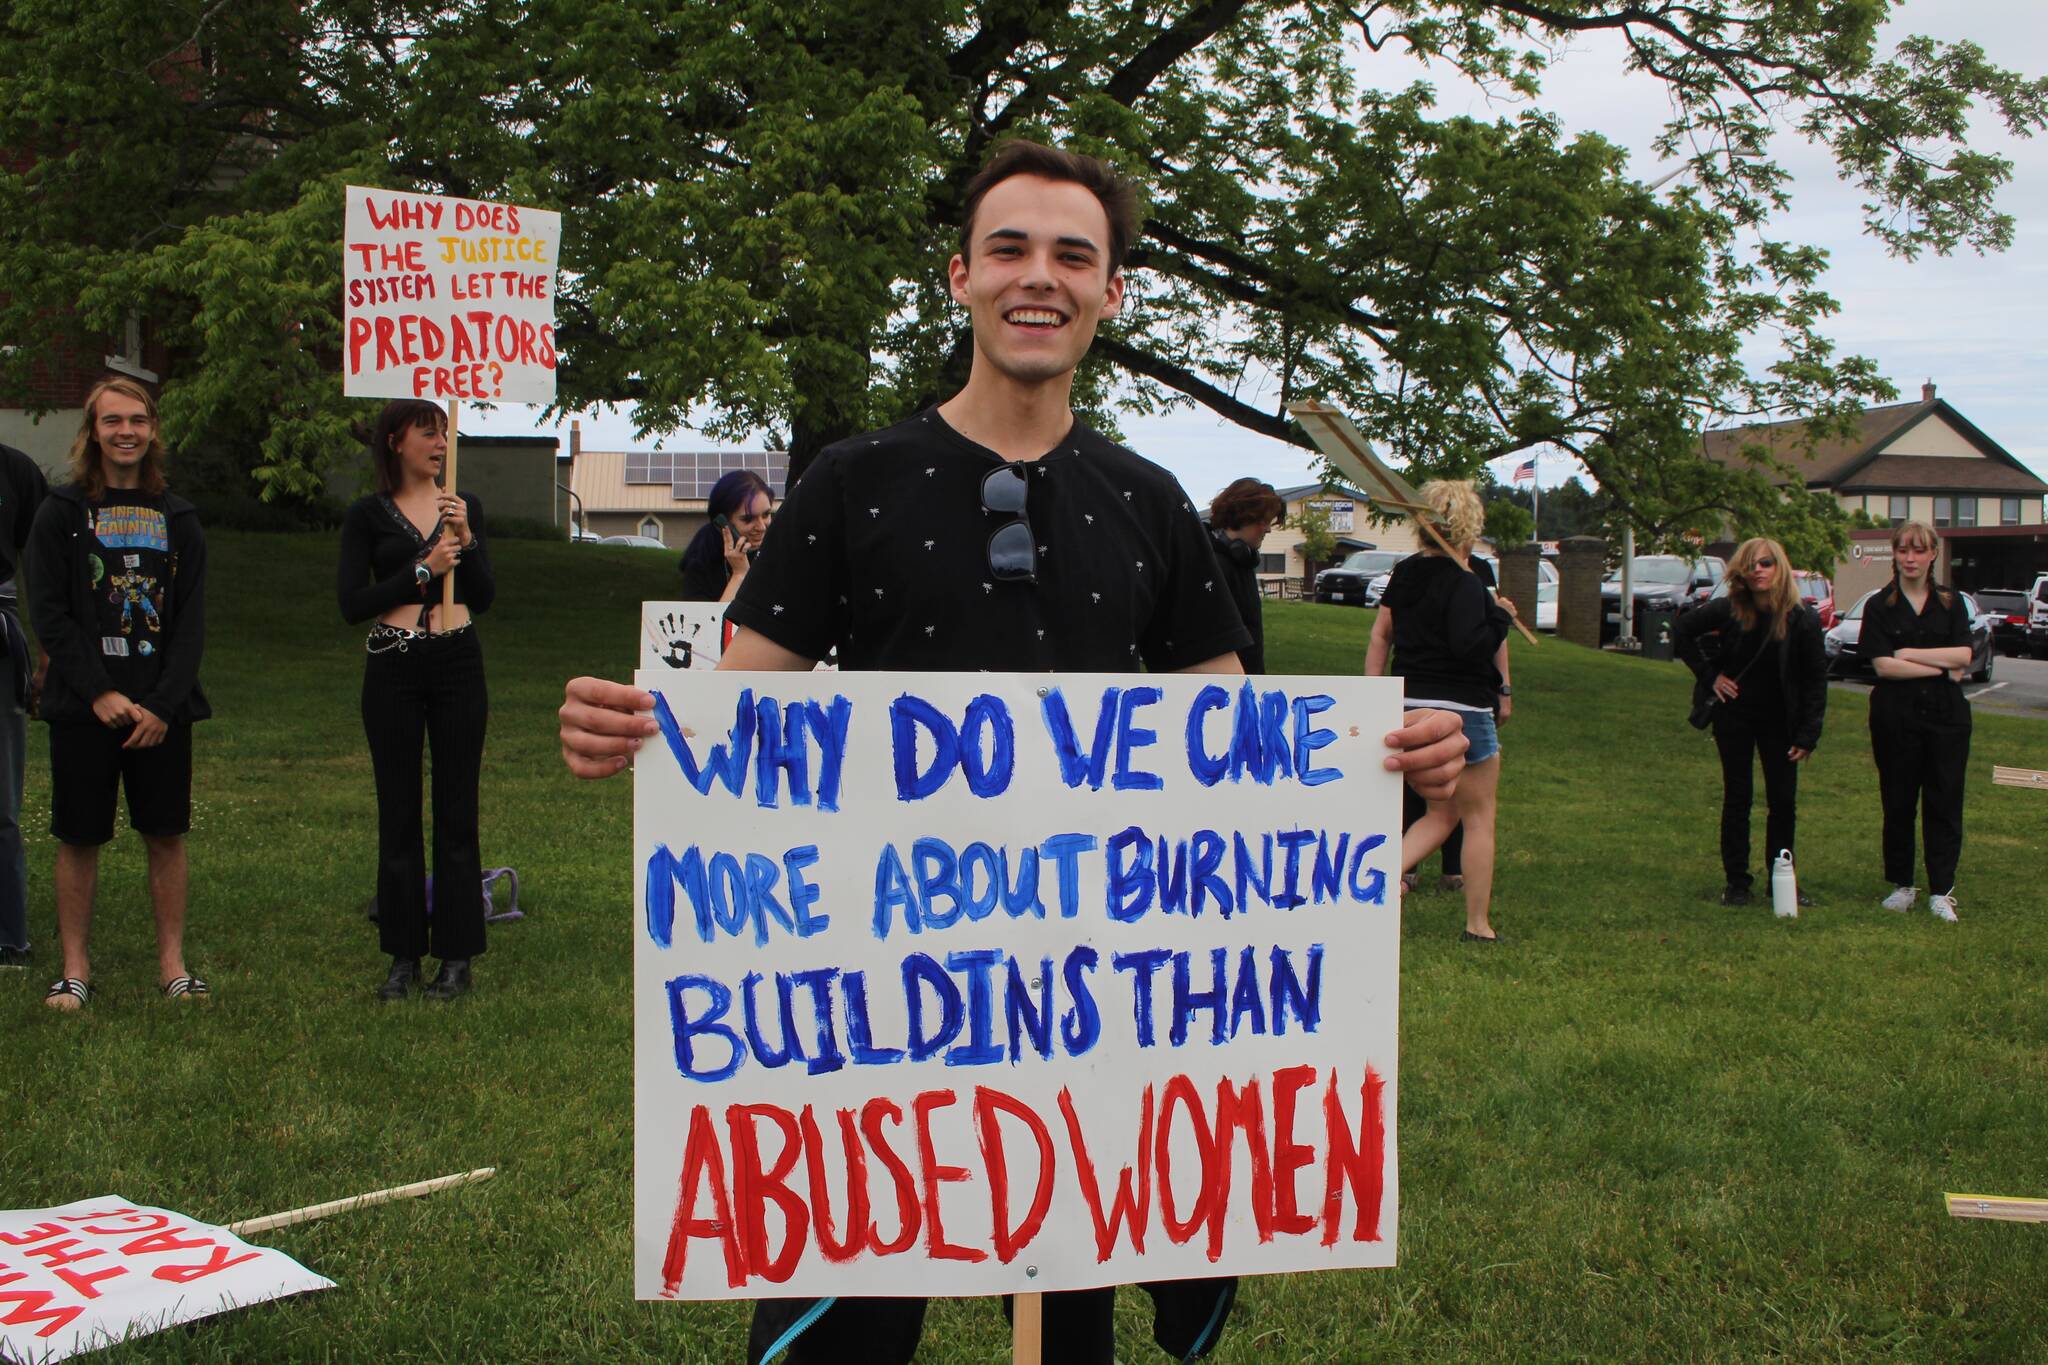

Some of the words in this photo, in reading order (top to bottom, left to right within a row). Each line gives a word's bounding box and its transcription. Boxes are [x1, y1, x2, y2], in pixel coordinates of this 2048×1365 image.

[366, 197, 444, 230] WHY
[455, 203, 521, 235] DOES
[349, 241, 426, 273] THE
[437, 236, 549, 264] JUSTICE
[349, 273, 436, 307] SYSTEM
[451, 272, 496, 300] LET
[500, 271, 548, 299] THE
[349, 311, 557, 375] PREDATORS
[413, 361, 504, 399] FREE?
[649, 687, 853, 813] WHY
[889, 690, 1015, 801] DO
[1184, 677, 1345, 788] CARE
[645, 840, 830, 949] MORE
[872, 832, 1098, 943] ABOUT
[1105, 823, 1387, 923] BURNING
[664, 944, 1101, 1082] BUILDINS
[1113, 942, 1325, 1050] THAN
[658, 1085, 1056, 1299] ABUSED
[1057, 1060, 1387, 1264] WOMEN
